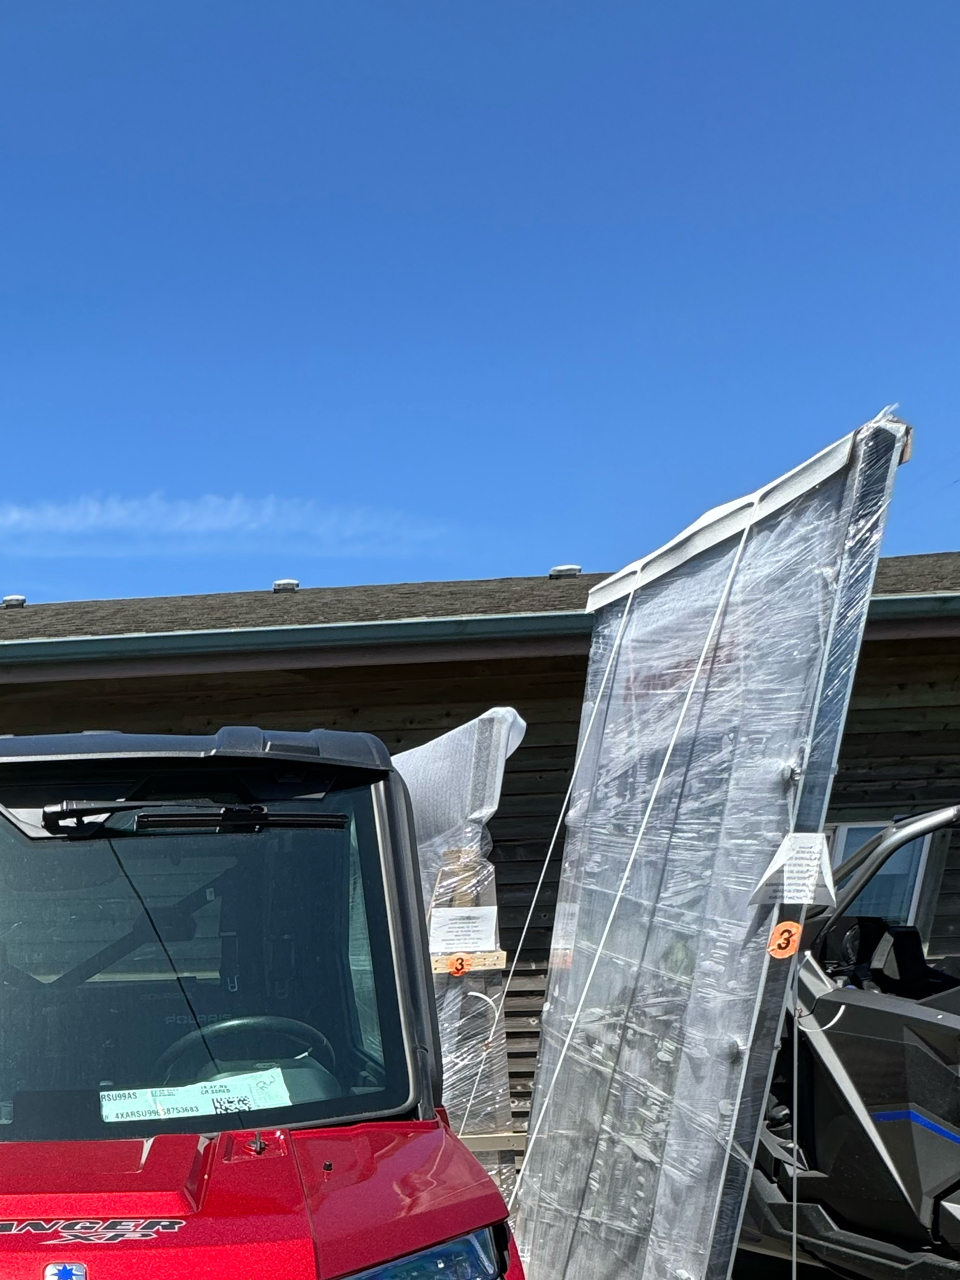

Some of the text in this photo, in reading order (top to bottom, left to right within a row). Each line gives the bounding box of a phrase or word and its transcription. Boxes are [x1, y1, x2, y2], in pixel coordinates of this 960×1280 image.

[777, 928, 793, 951] 3
[454, 957, 465, 972] 3
[100, 1091, 138, 1102] RSU99AS
[39, 1231, 157, 1244] XP
